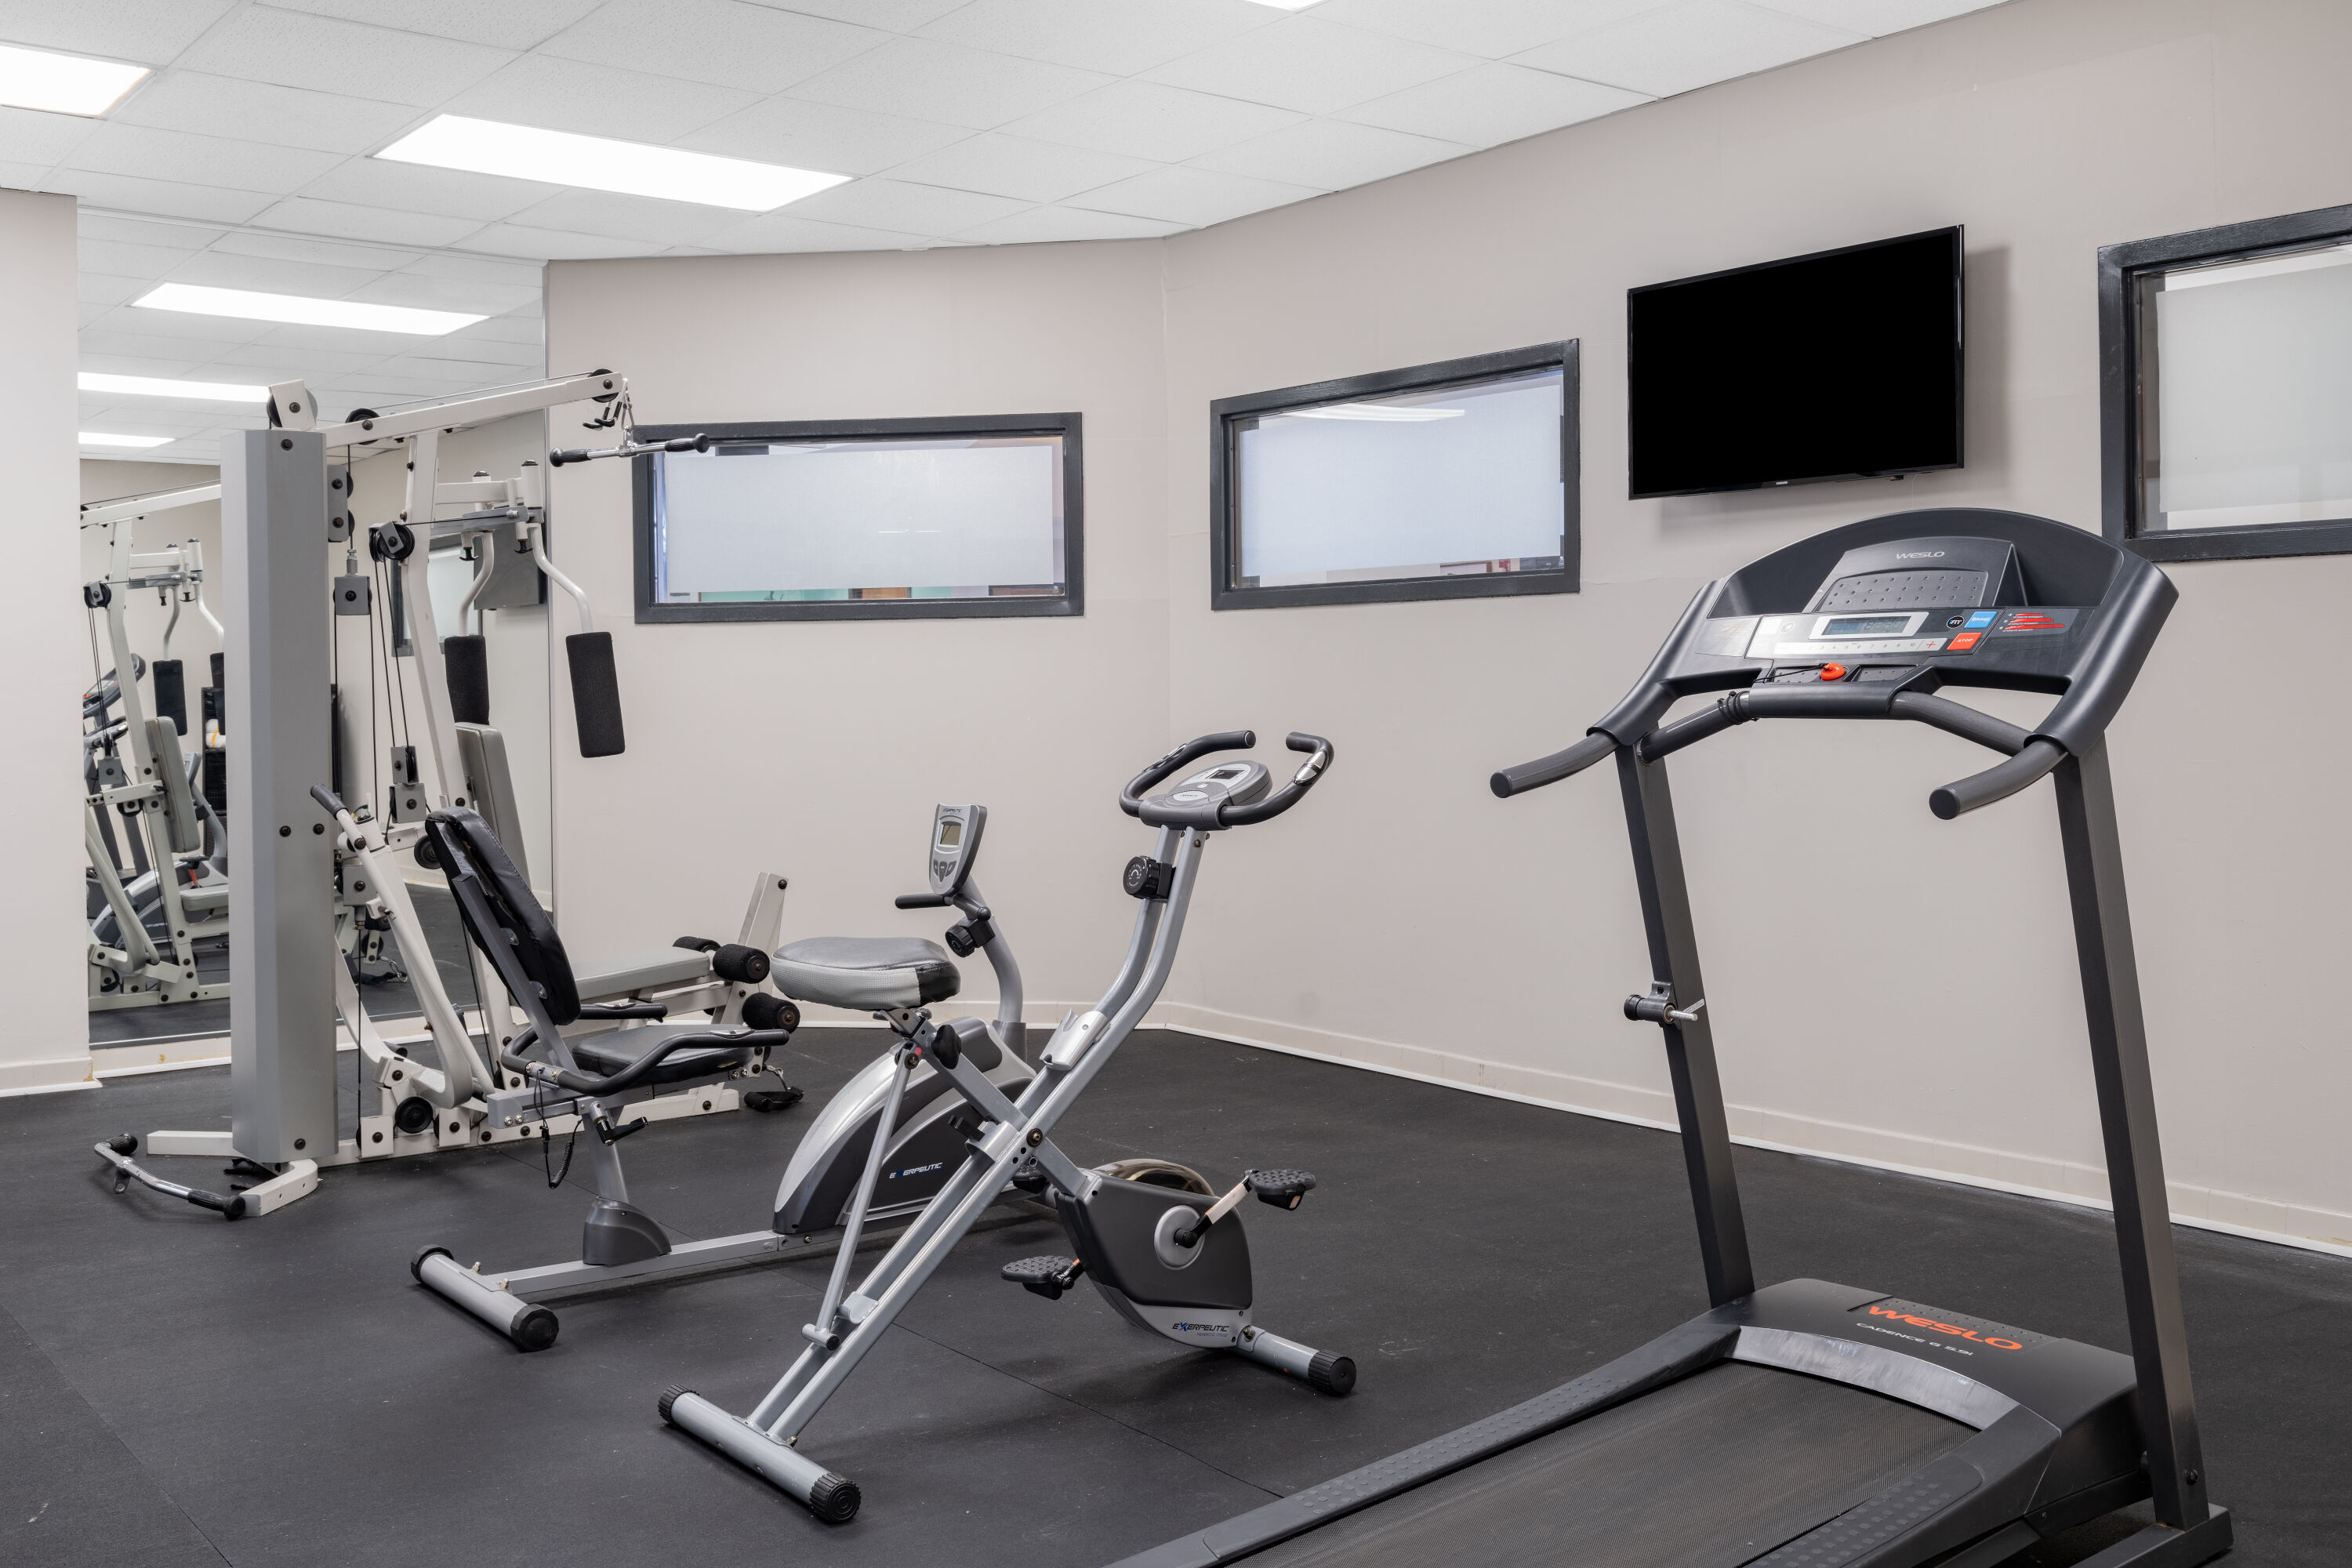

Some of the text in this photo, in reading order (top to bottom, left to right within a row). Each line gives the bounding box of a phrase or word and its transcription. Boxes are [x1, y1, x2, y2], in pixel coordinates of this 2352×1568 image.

[1896, 551, 1945, 560] WESLO
[1172, 1322, 1229, 1332] EXERPEUTIC
[1856, 1323, 1926, 1343] CADENCE
[1869, 1306, 2023, 1349] WESLO
